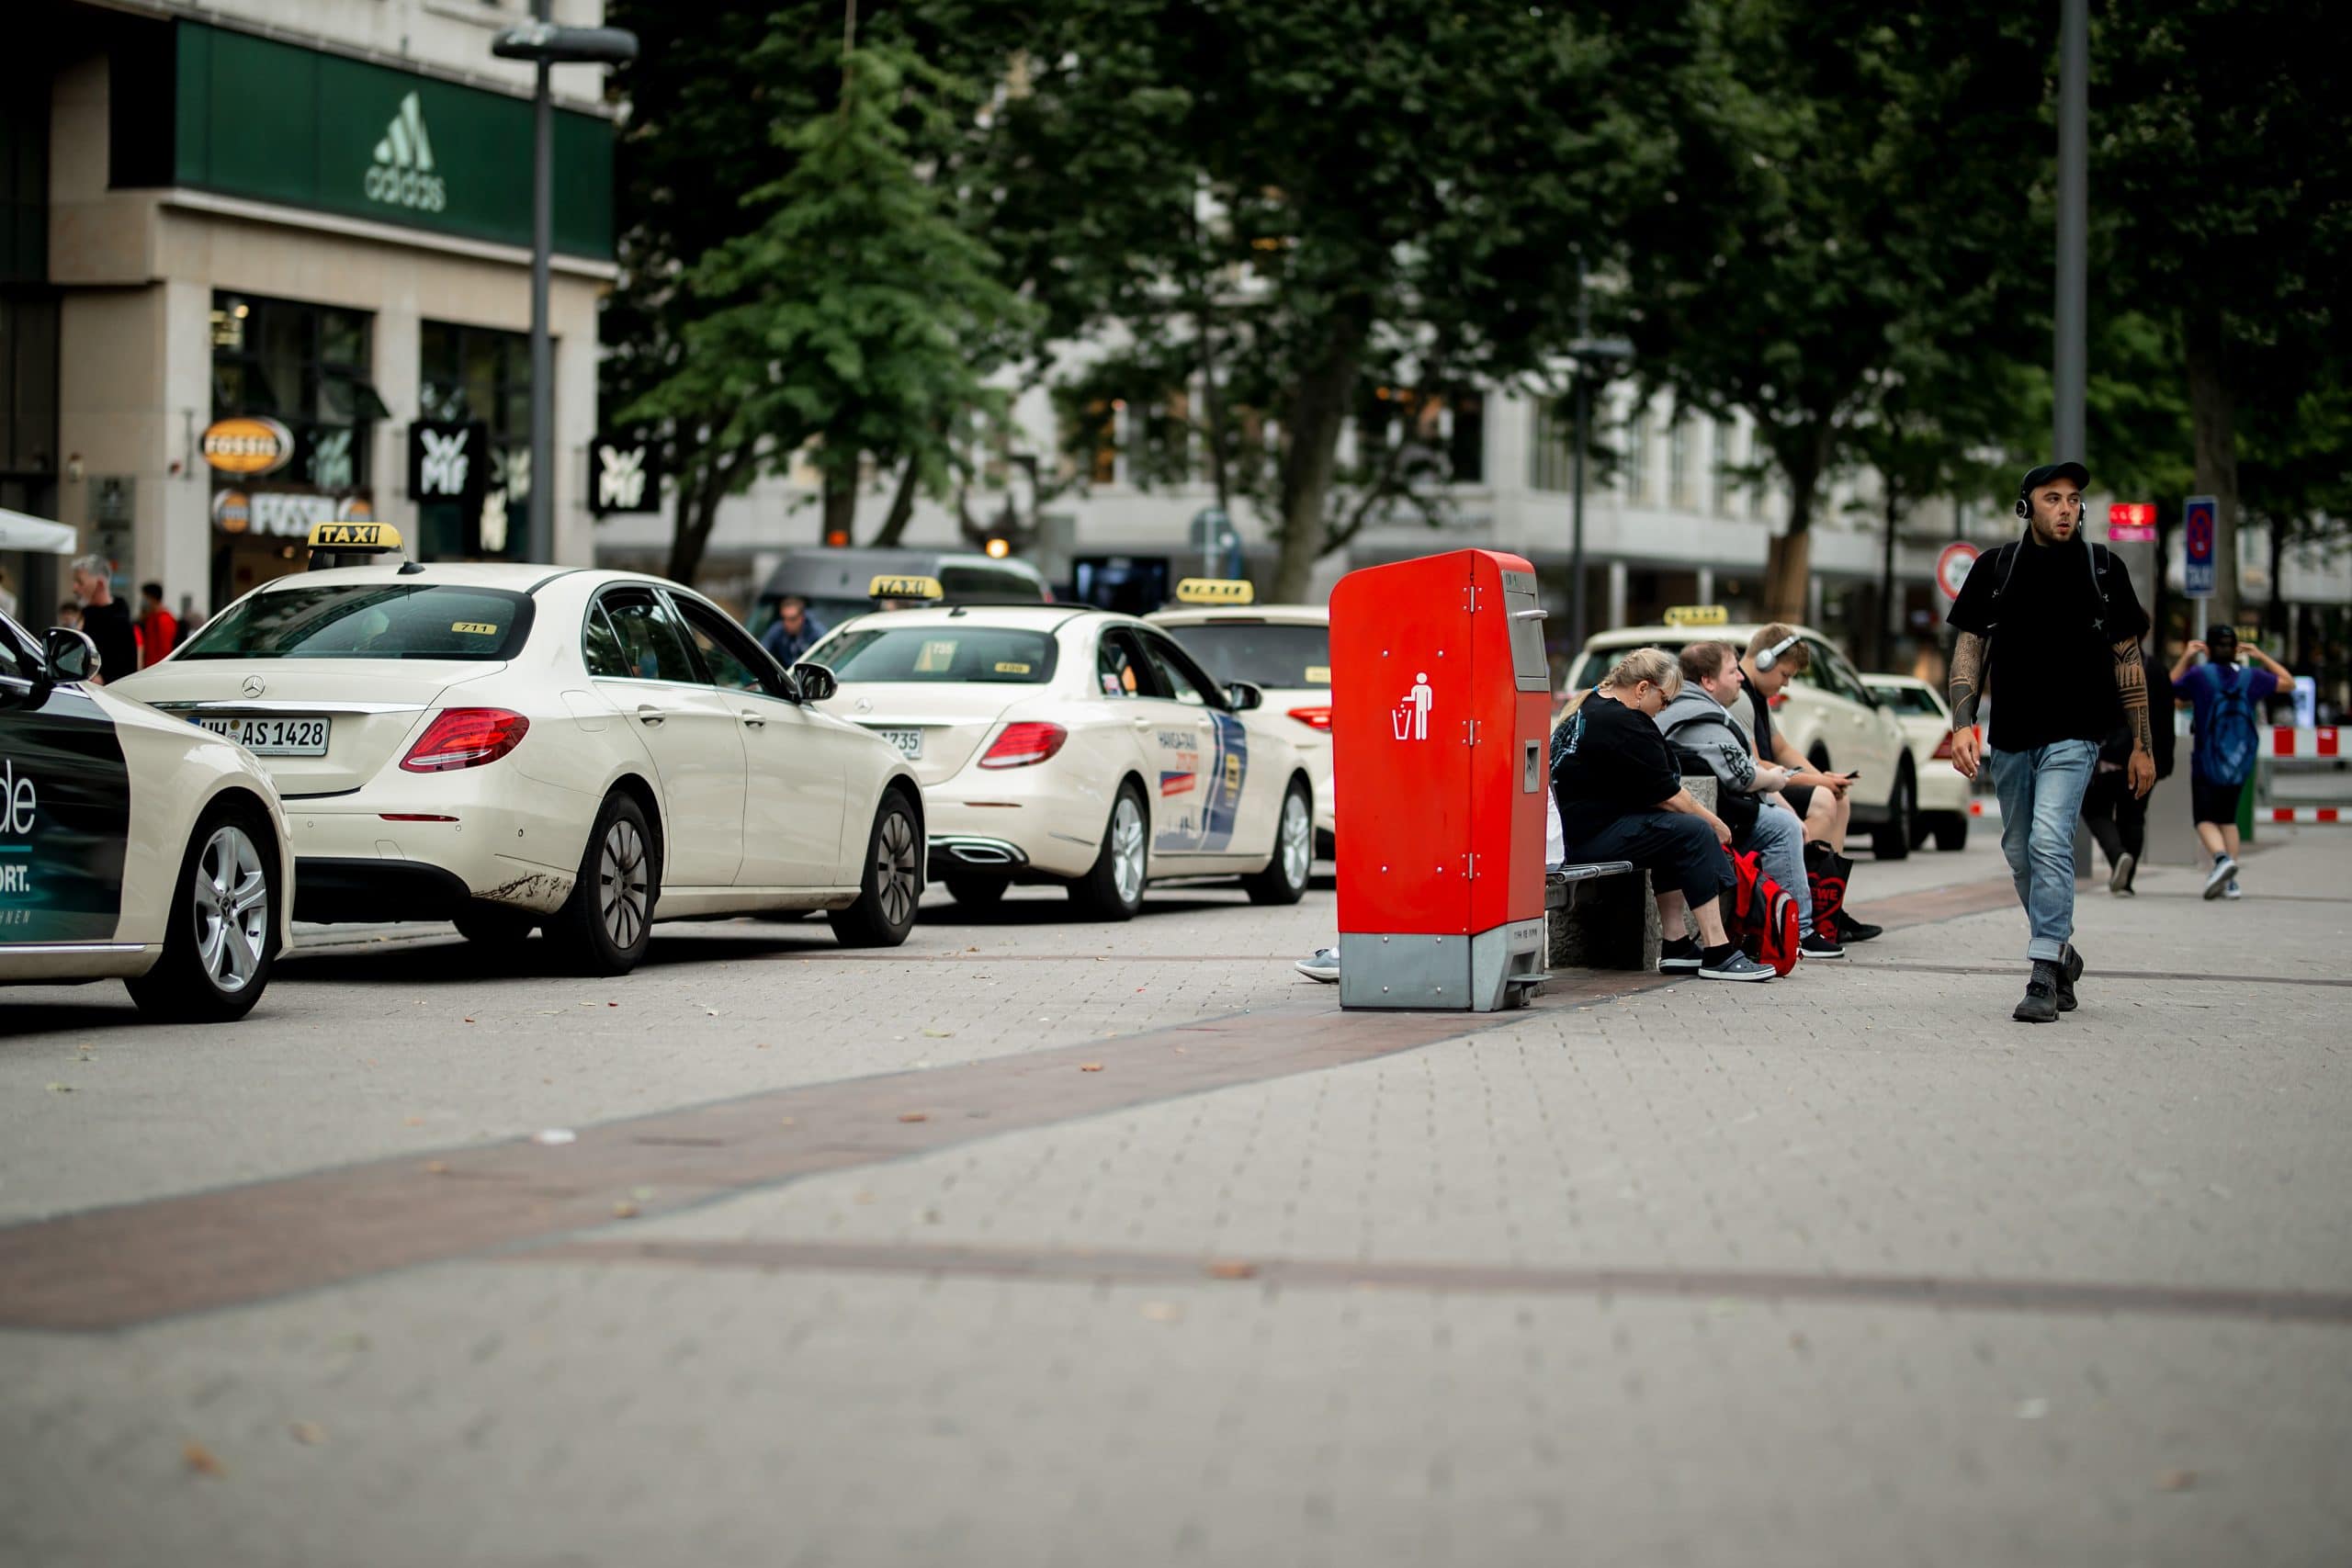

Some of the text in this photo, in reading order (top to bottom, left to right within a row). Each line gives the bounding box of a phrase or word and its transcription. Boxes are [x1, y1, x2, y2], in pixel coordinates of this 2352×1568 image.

[365, 164, 447, 212] adidas
[322, 526, 378, 543] TAXI
[879, 580, 925, 594] TAXI
[461, 624, 488, 633] 711
[242, 722, 268, 746] AS
[272, 722, 324, 746] 1428
[882, 732, 919, 750] 735
